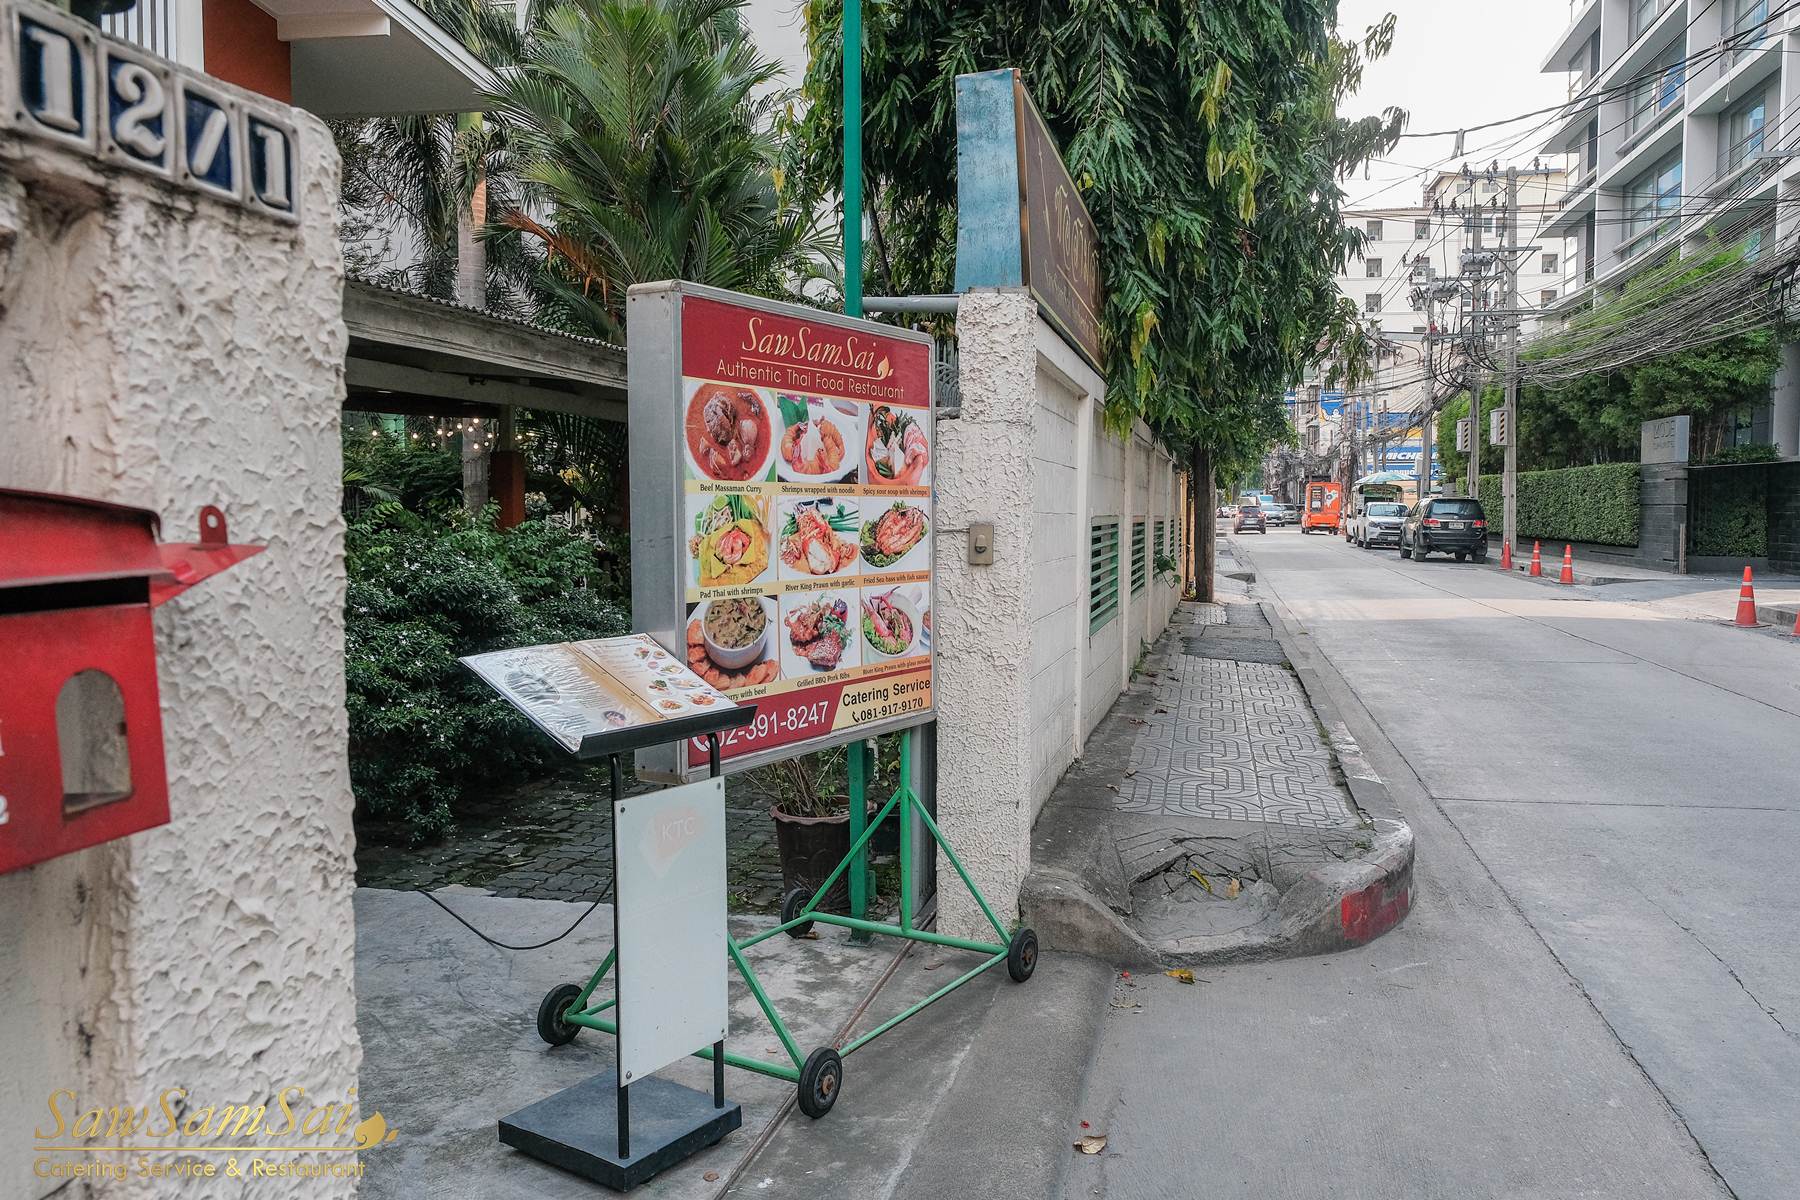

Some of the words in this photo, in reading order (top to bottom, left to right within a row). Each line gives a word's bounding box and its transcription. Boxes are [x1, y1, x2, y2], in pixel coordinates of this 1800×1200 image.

[28, 26, 290, 206] 12/1
[717, 359, 782, 383] Authentic
[787, 369, 811, 386] Thai
[816, 373, 844, 391] Food
[849, 379, 904, 398] Restaurant
[700, 483, 713, 492] Beef
[715, 484, 745, 492] Massaman
[746, 485, 762, 494] Curry
[782, 486, 802, 495] Shrimps
[804, 486, 826, 495] wrapped
[827, 486, 837, 494] with
[839, 486, 855, 494] noodle
[863, 487, 876, 496] Spicy
[910, 488, 928, 496] shrimps
[785, 584, 799, 592] River
[800, 583, 812, 591] King
[830, 580, 840, 588] with
[841, 579, 855, 588] garlic
[700, 591, 711, 599] Pad
[713, 589, 726, 597] Thai
[727, 588, 740, 596] with
[741, 586, 763, 595] shrimps
[797, 677, 814, 688] Grilled
[815, 675, 827, 684] BBQ
[827, 674, 838, 682] Pork
[740, 689, 753, 698] with
[754, 686, 767, 695] beef
[842, 687, 889, 707] Catering
[893, 679, 931, 696] Service
[860, 697, 923, 721] 081-917-9170
[661, 816, 696, 840] KTC
